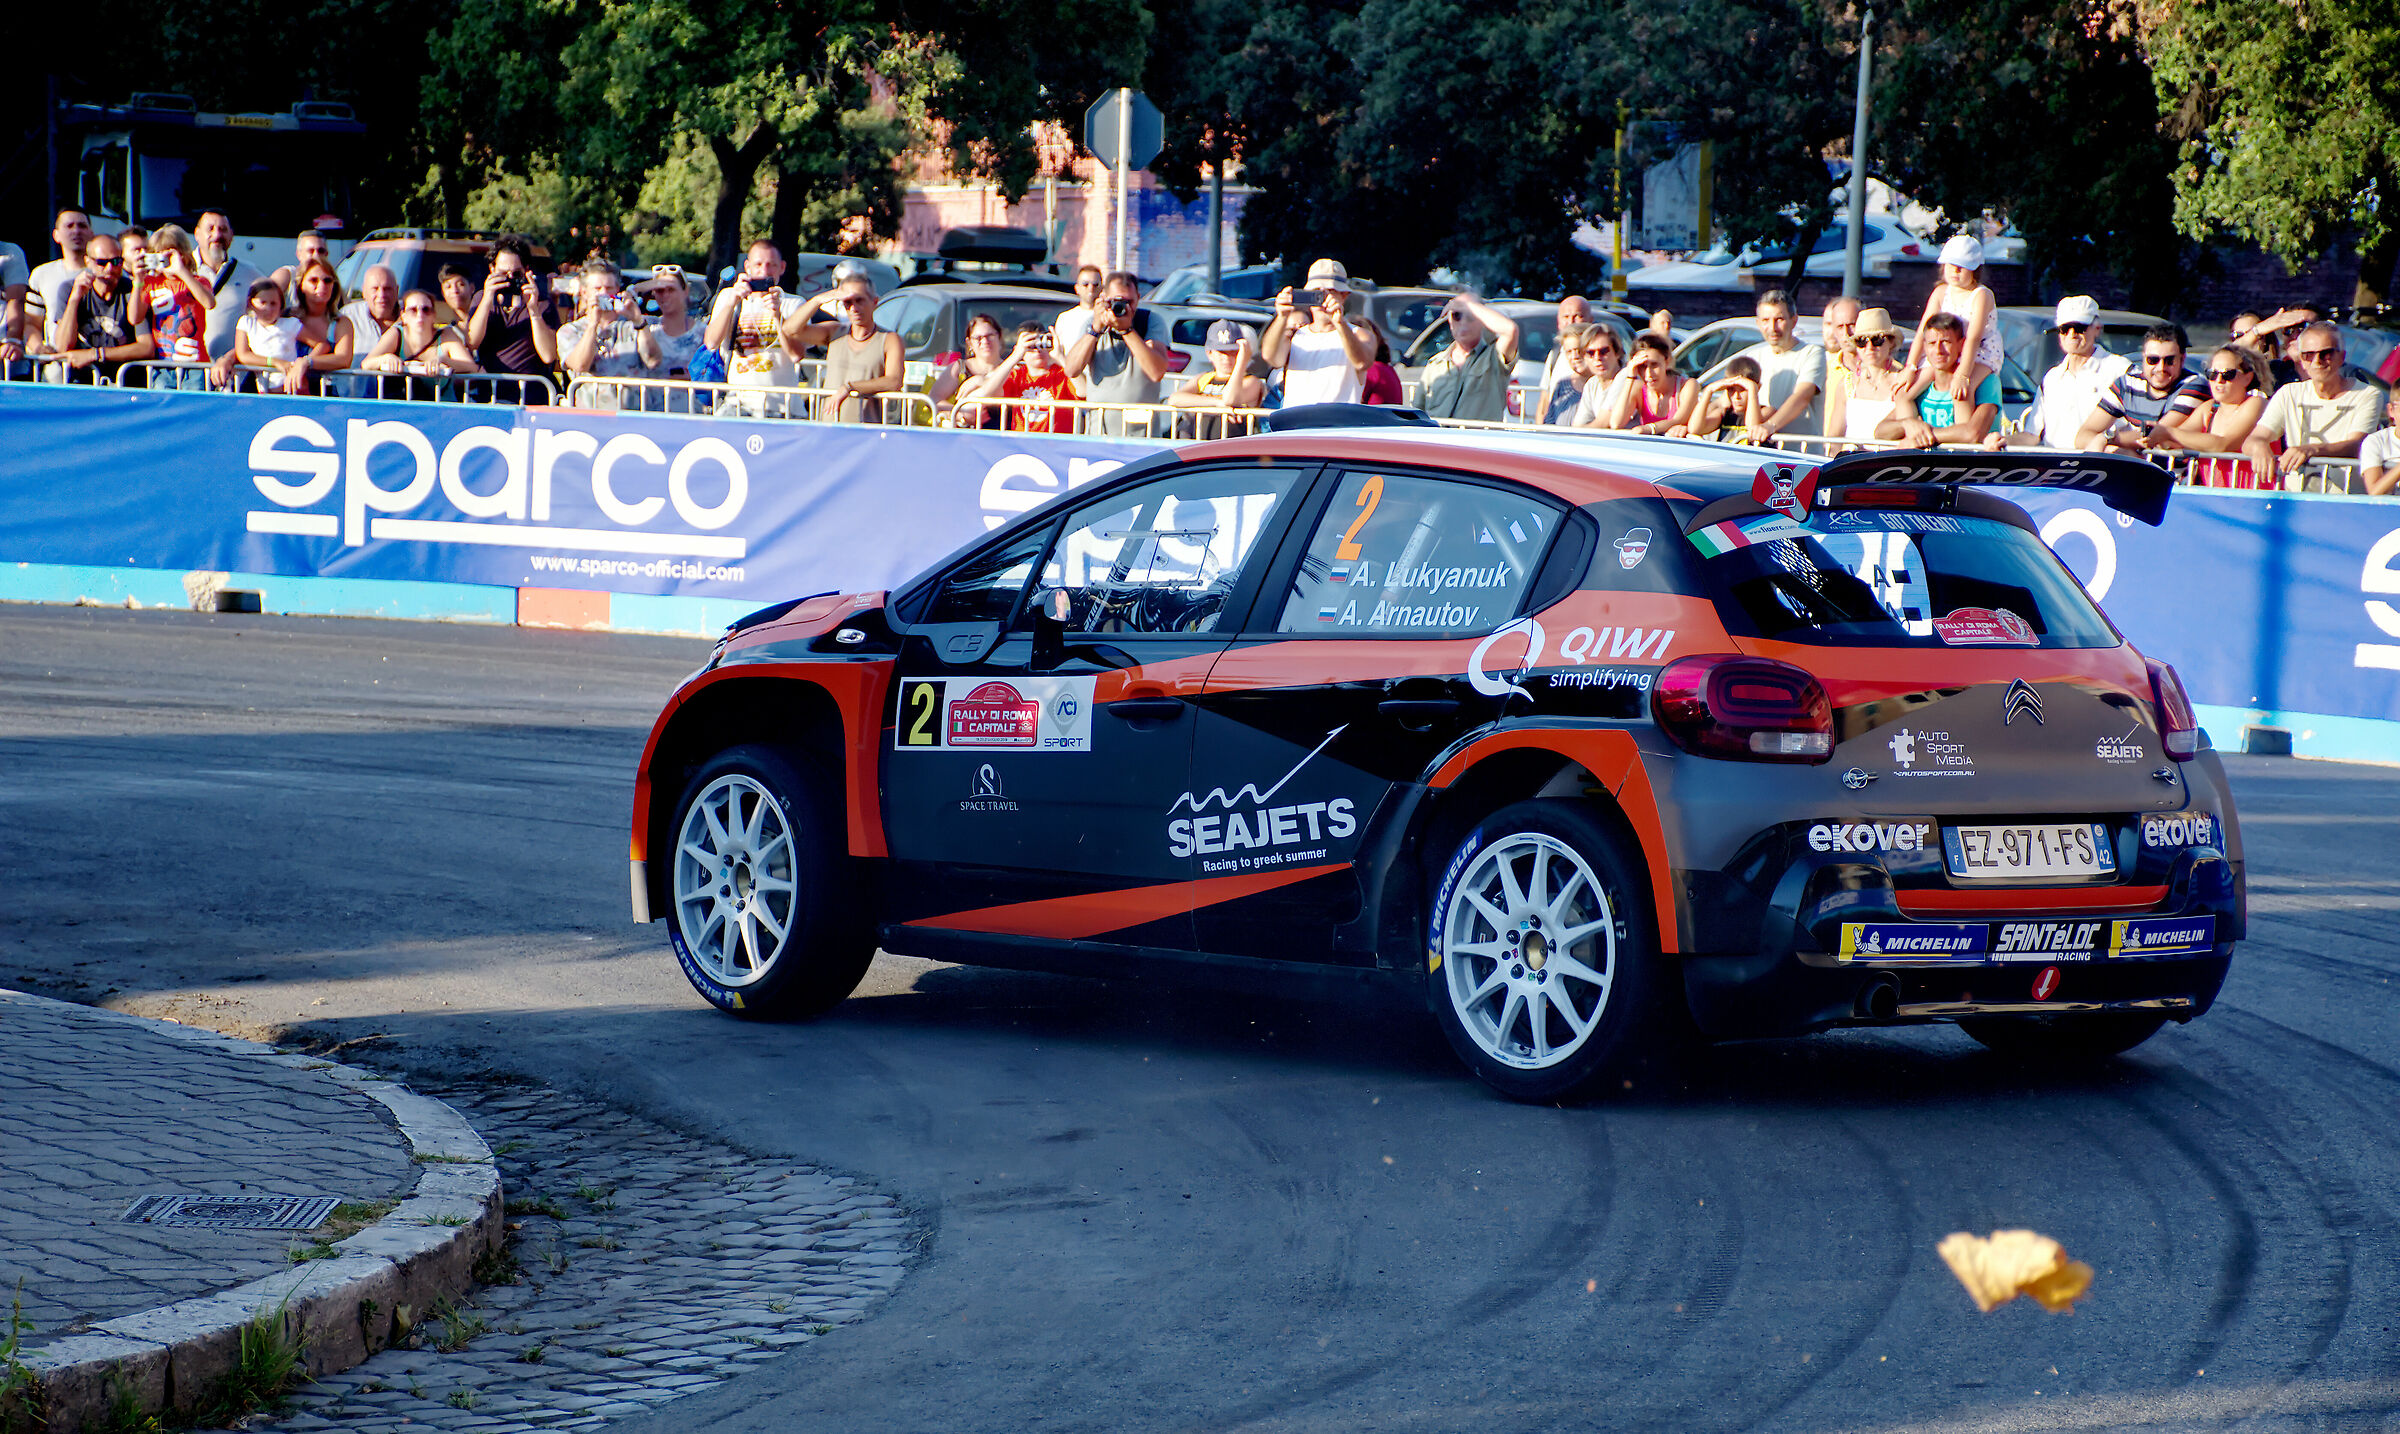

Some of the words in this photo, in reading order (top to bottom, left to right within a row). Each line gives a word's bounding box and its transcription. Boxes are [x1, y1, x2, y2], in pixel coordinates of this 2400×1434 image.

[248, 415, 748, 547] sparco
[1865, 460, 2108, 487] CITROËN
[1335, 475, 1385, 561] 2
[1878, 513, 1912, 531] GOT
[1904, 513, 1966, 534] TALENT?
[530, 555, 745, 582] www.sparco-official.com
[1350, 560, 1376, 588] A.
[1384, 561, 1511, 595] Lukyanuk
[1338, 599, 1362, 626] A.
[1367, 600, 1480, 627] Arnautov
[1560, 626, 1676, 665] QIWI
[1550, 668, 1652, 691] simplifying
[908, 682, 935, 745] 2
[953, 709, 988, 720] RALLY
[989, 710, 1000, 720] DI
[1002, 710, 1034, 721] ROMA
[1057, 700, 1077, 716] ACI
[969, 722, 1017, 733] CAPITALE
[1917, 730, 1949, 741] AUTO
[1044, 737, 1083, 748] SPORT
[1926, 742, 1965, 754] SPORT
[2096, 745, 2144, 759] SEAJETS
[960, 801, 986, 811] SPACE
[987, 801, 1019, 811] TRAVEL
[1168, 797, 1357, 858] SEAJETS
[1808, 824, 1930, 852] ekover
[2144, 818, 2212, 847] ekover
[1960, 827, 2094, 868] EZ-971-FS
[2099, 849, 2112, 865] 42
[1203, 858, 1238, 872] Racing
[1239, 856, 1251, 868] to
[1253, 851, 1284, 869] greek
[1285, 848, 1327, 862] summer
[1953, 855, 1960, 866] F
[1432, 835, 1477, 932] MICHELIN
[1885, 937, 1973, 950] MICHELIN
[2143, 929, 2205, 945] MICHELIN
[2057, 952, 2091, 962] RACING
[674, 940, 722, 1000] MICHELIN
